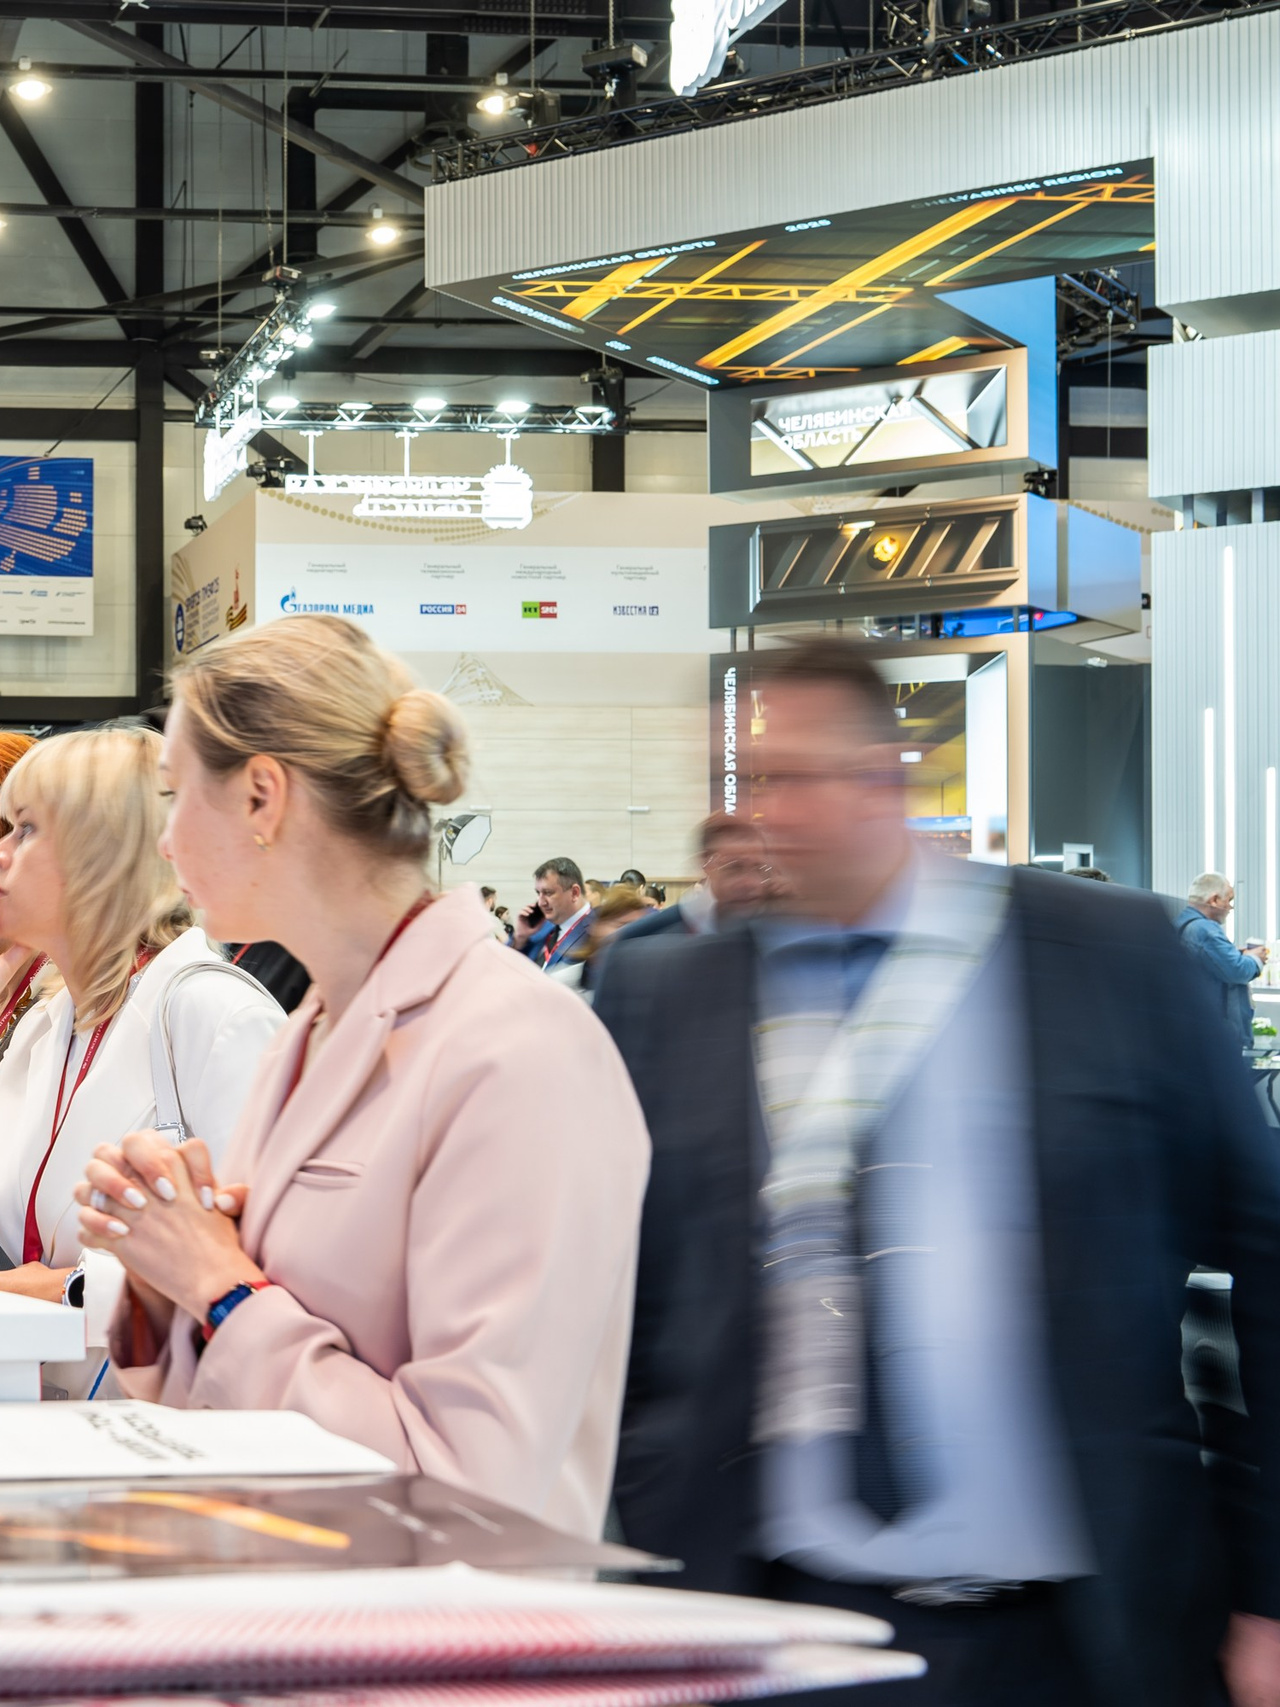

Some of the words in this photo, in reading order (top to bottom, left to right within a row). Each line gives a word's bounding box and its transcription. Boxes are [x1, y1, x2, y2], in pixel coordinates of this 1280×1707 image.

[910, 181, 1041, 210] CHELYABINSK
[1042, 166, 1123, 187] REGION
[784, 218, 833, 233] 2025
[511, 254, 634, 281] ЧЕЛЯБИНСКАЯ
[633, 239, 717, 260] ОБЛАСТЬ
[777, 400, 912, 433] ЧЕЛЯБИНСКАЯ
[343, 604, 374, 615] МЕДИА
[421, 605, 454, 614] РОССИЯ
[613, 605, 647, 616] ИЗВЕСТИЯ
[724, 667, 737, 771] ЧЕЛЯБИНСКАЯ
[724, 773, 737, 816] ОБЛА
